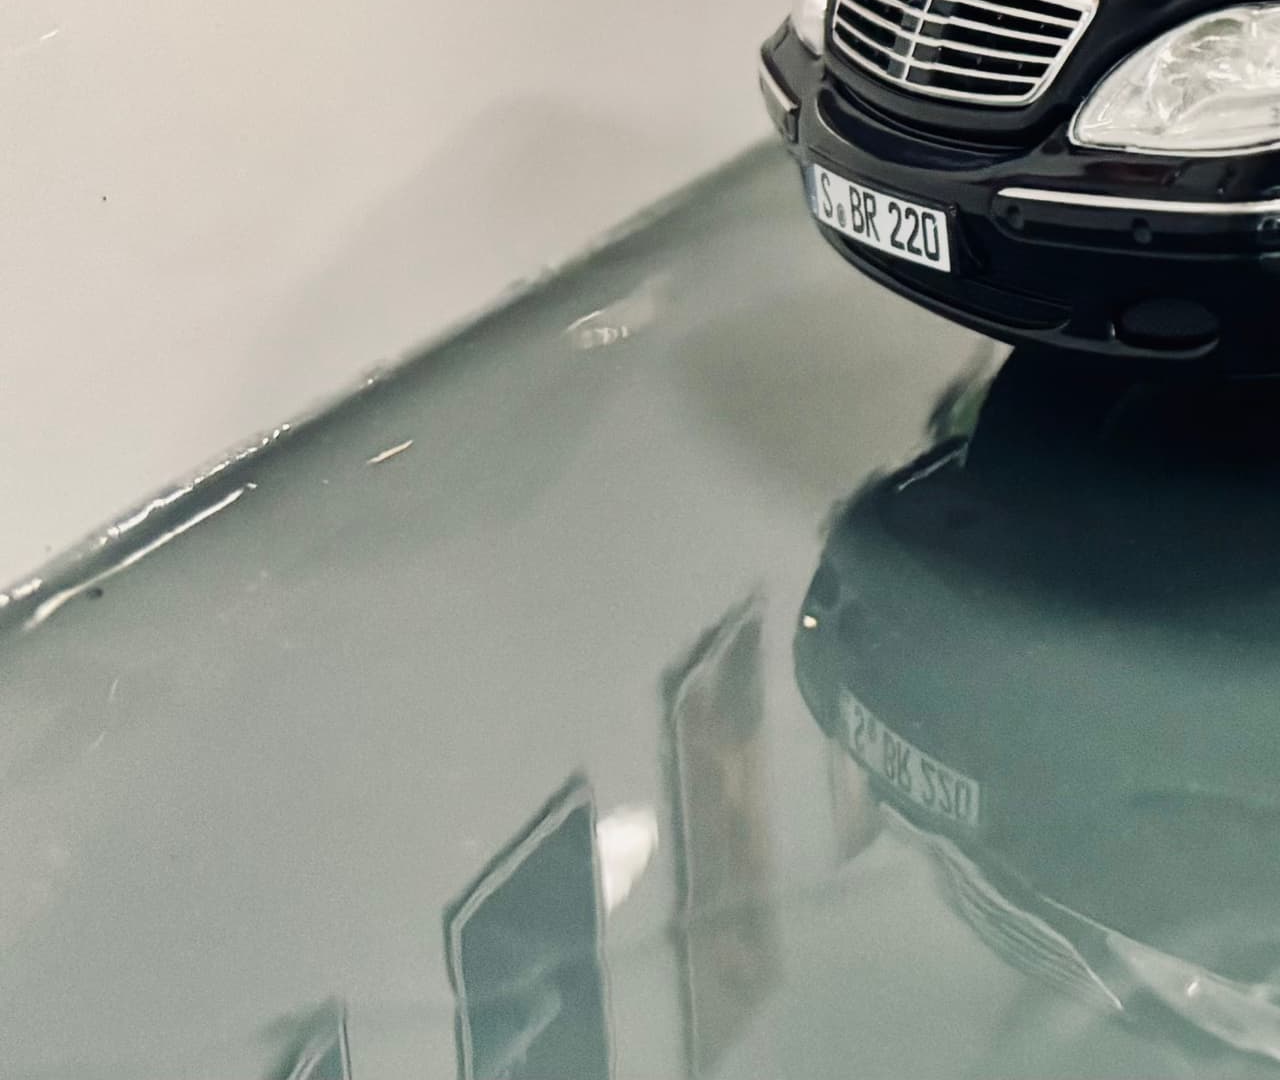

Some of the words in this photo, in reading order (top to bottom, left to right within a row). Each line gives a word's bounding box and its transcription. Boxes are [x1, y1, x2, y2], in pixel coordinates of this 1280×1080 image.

[821, 172, 833, 218] S
[849, 185, 880, 242] BR
[888, 201, 940, 261] 220
